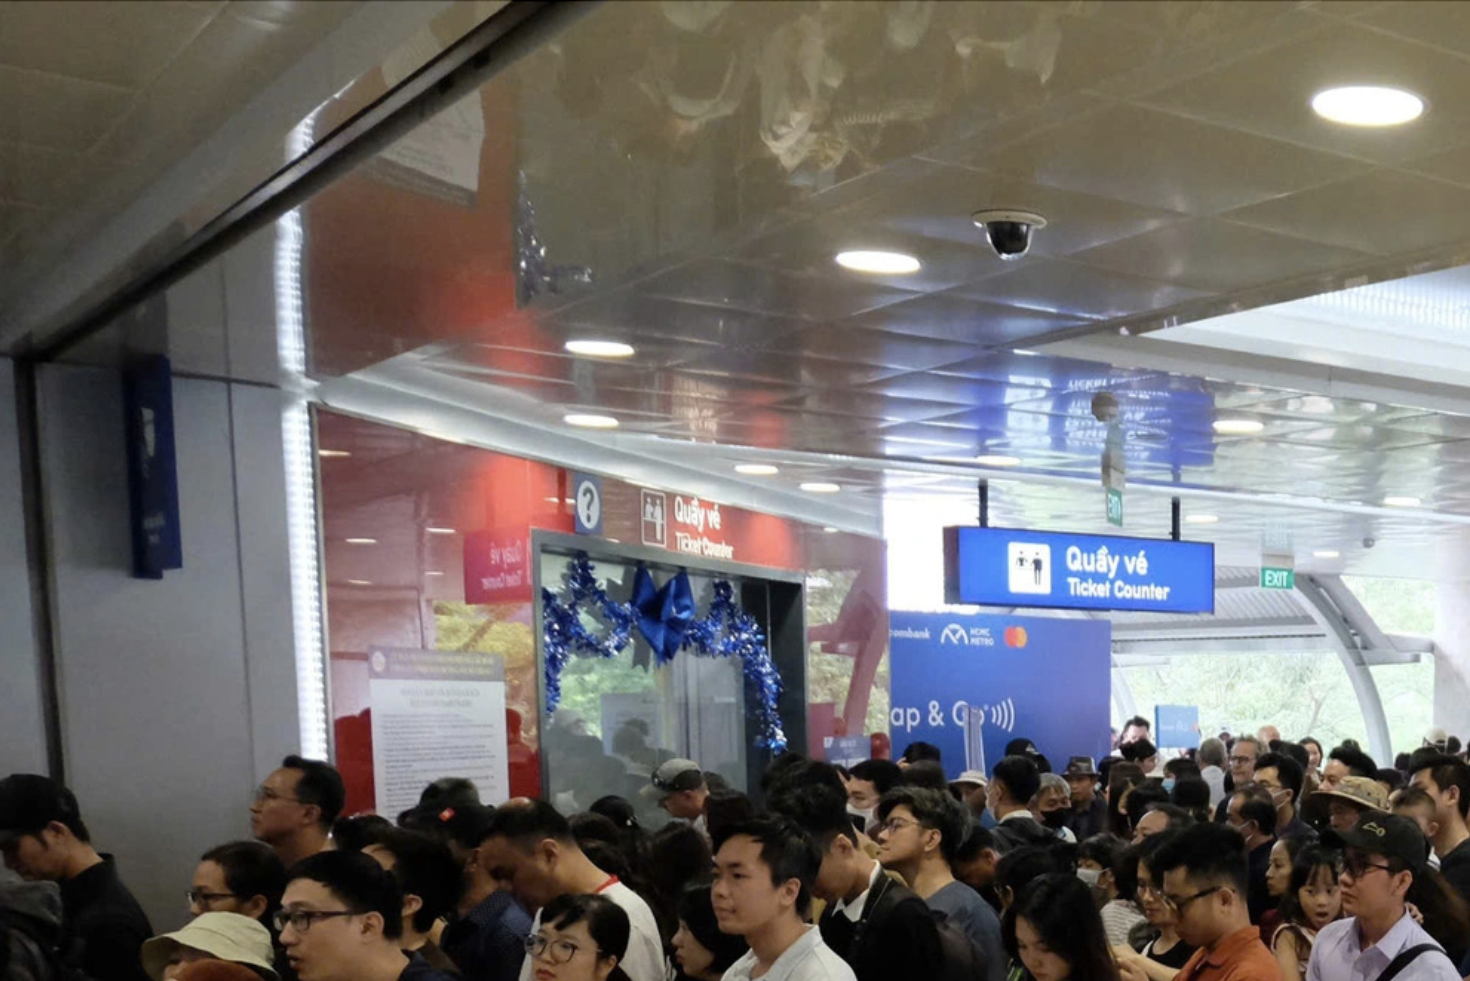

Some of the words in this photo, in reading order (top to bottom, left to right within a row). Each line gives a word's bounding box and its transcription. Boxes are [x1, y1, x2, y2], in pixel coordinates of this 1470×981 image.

[675, 495, 705, 532] Quầy
[707, 503, 722, 531] vé
[675, 532, 701, 554] Ticket
[702, 536, 734, 560] Counter
[1066, 545, 1119, 579] Quầy
[1124, 550, 1149, 576] vé
[1067, 577, 1111, 598] Ticket
[1114, 579, 1170, 600] Counter
[1264, 569, 1288, 588] EXIT
[970, 637, 995, 646] METRO
[928, 700, 946, 726] &
